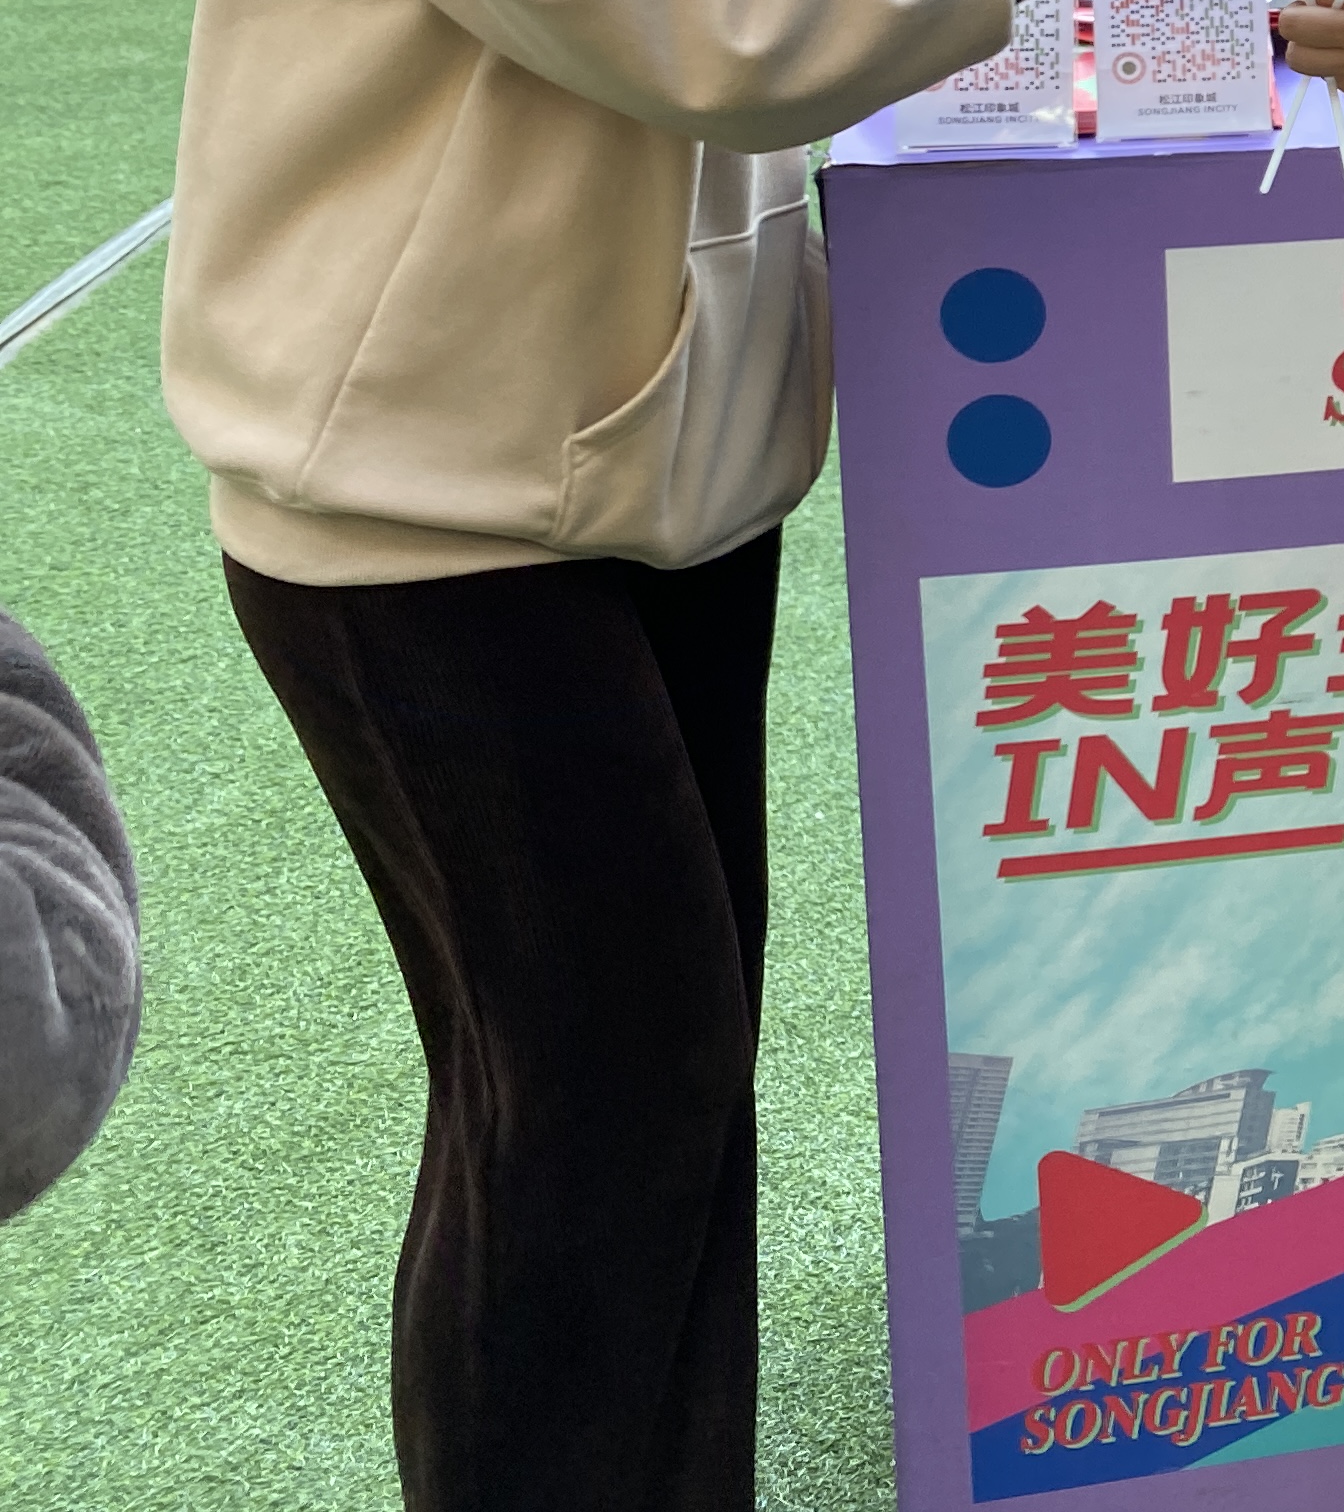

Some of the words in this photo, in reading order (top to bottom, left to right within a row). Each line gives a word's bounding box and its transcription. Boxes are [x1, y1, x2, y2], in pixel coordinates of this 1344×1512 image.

[1203, 103, 1239, 114] INCITY
[1030, 1330, 1200, 1399] ONLY
[1205, 1310, 1323, 1372] FOR
